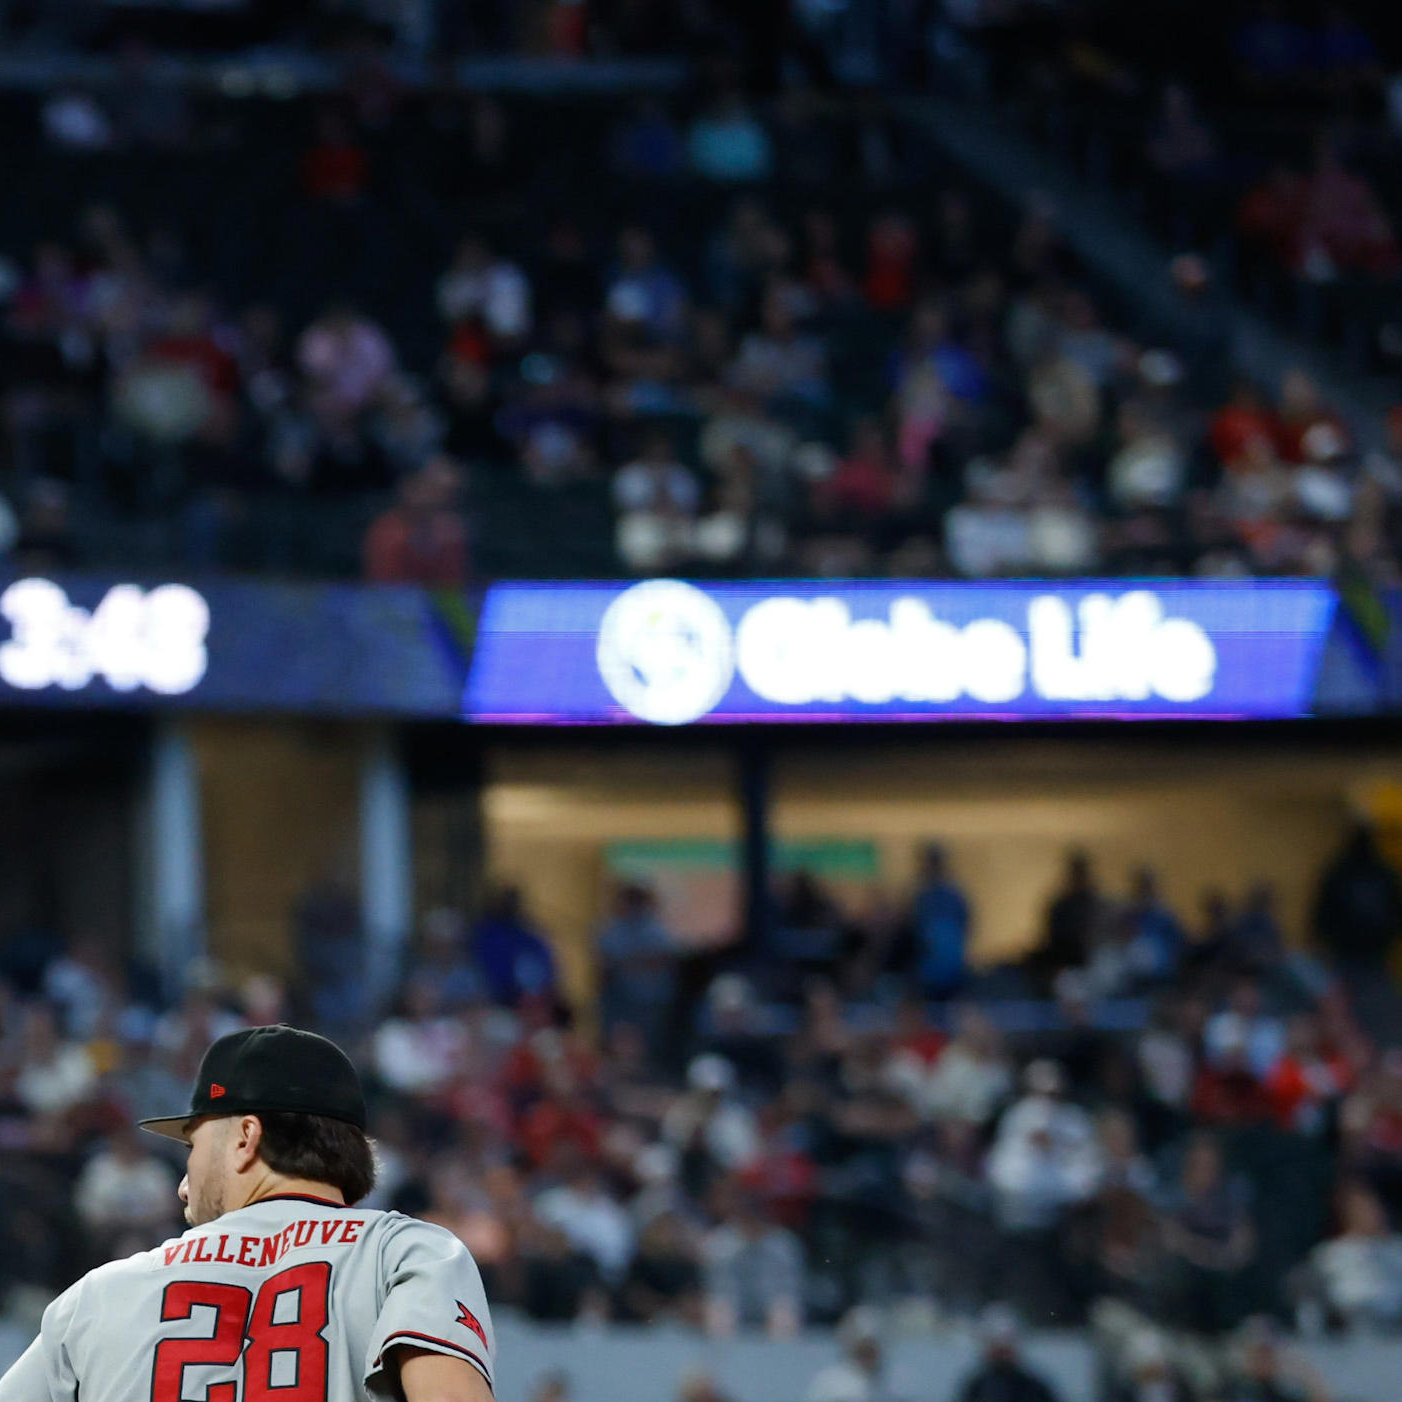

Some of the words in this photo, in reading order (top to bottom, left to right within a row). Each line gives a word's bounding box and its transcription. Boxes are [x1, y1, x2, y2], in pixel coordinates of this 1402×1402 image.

[737, 596, 1026, 703] Globe
[1028, 590, 1217, 702] Life
[163, 1219, 365, 1268] VILLENEUVE
